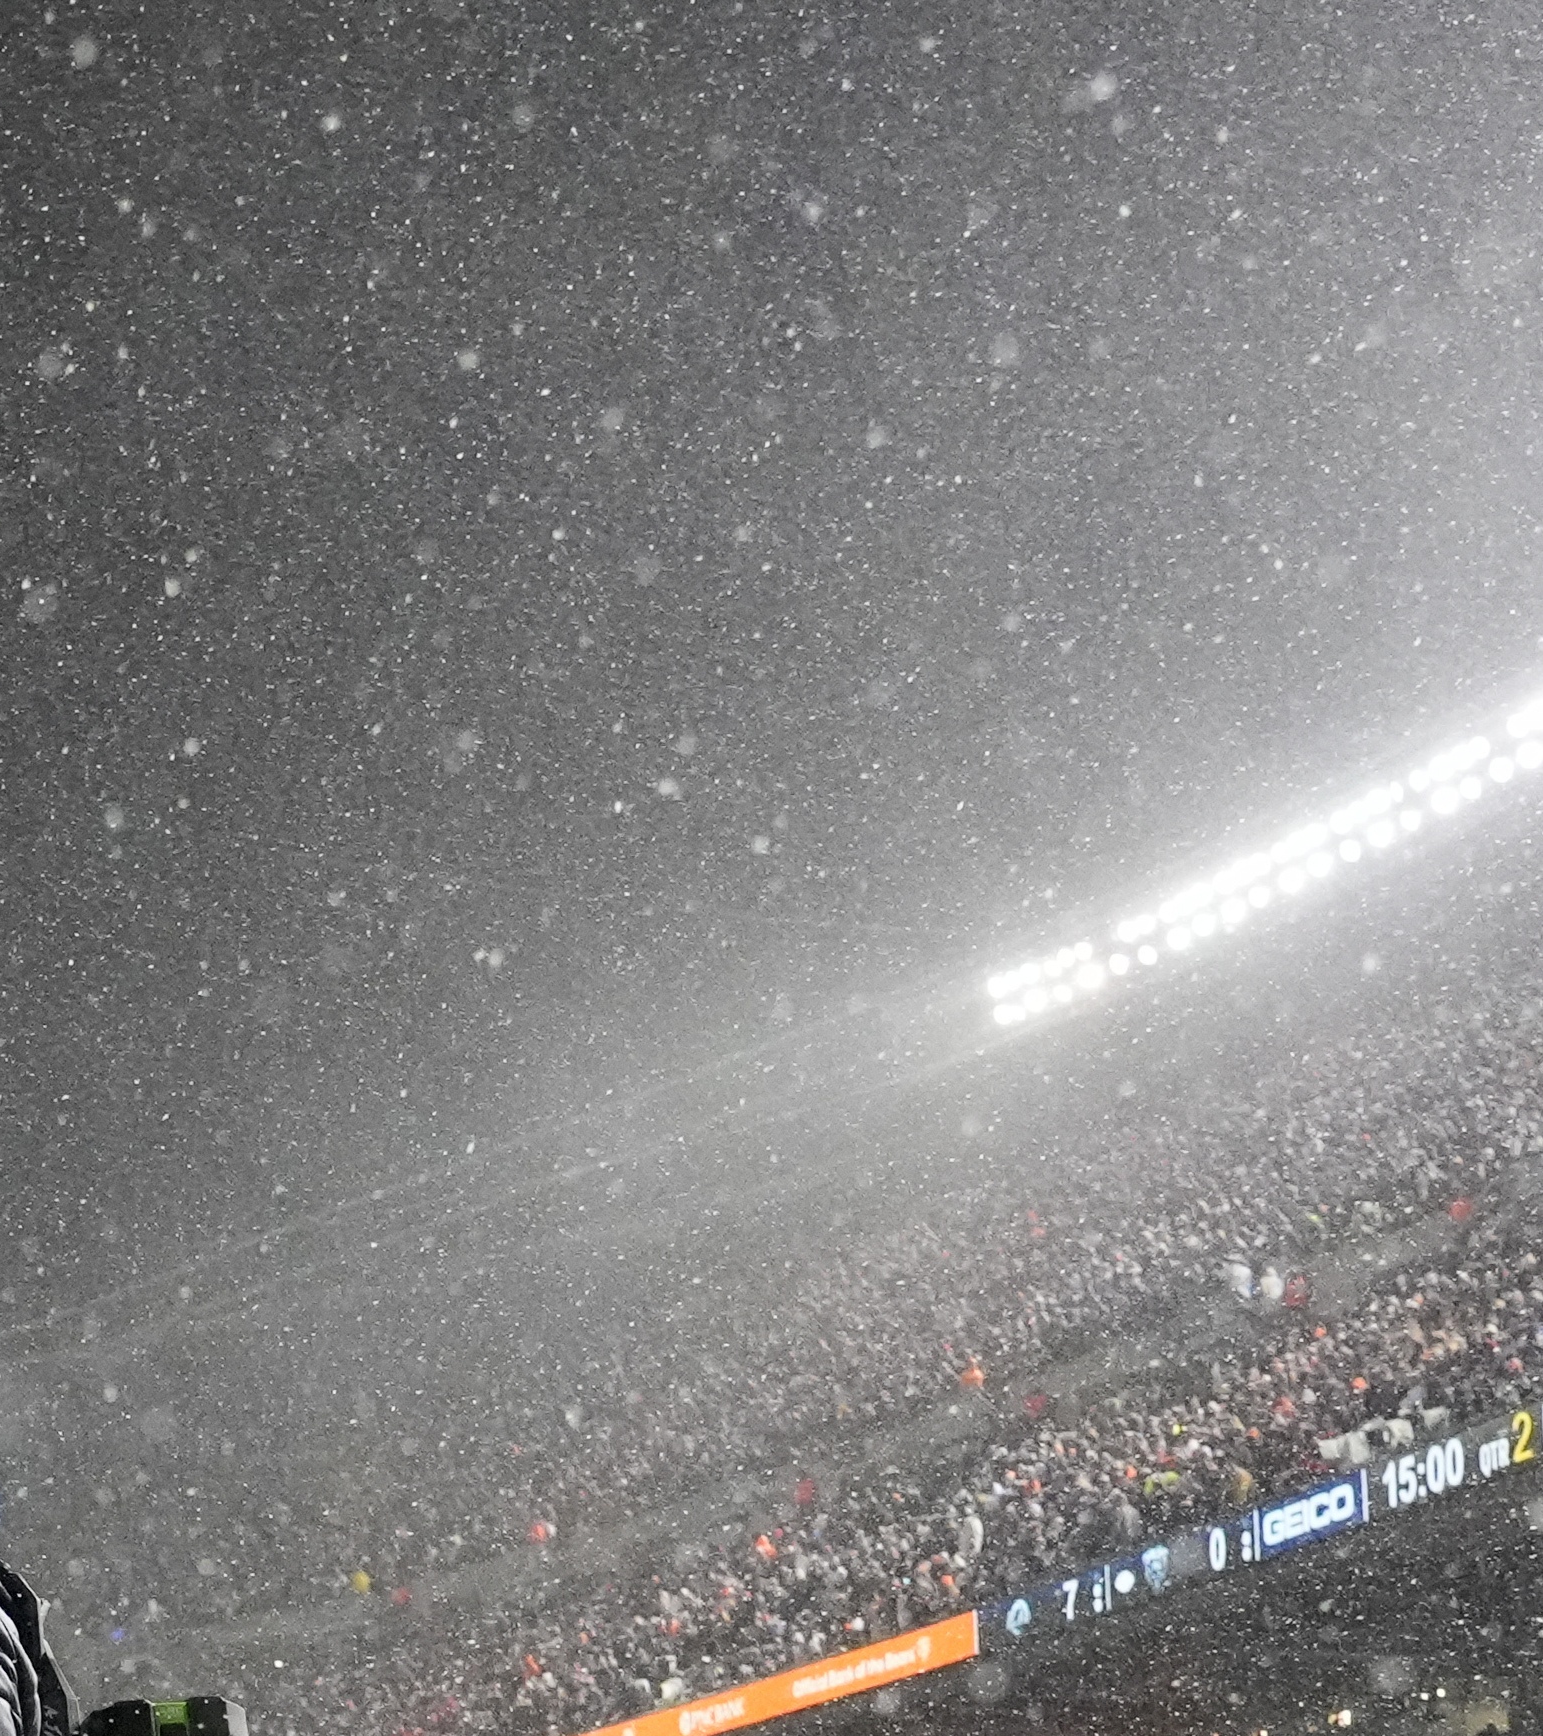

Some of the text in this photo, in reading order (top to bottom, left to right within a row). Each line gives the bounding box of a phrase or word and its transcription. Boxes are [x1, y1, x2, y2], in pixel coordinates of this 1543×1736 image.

[1382, 1437, 1464, 1509] 15:00
[1512, 1411, 1536, 1464] 2
[1262, 1483, 1355, 1547] GEICO
[1209, 1527, 1227, 1572] 0
[1062, 1579, 1080, 1620] 7
